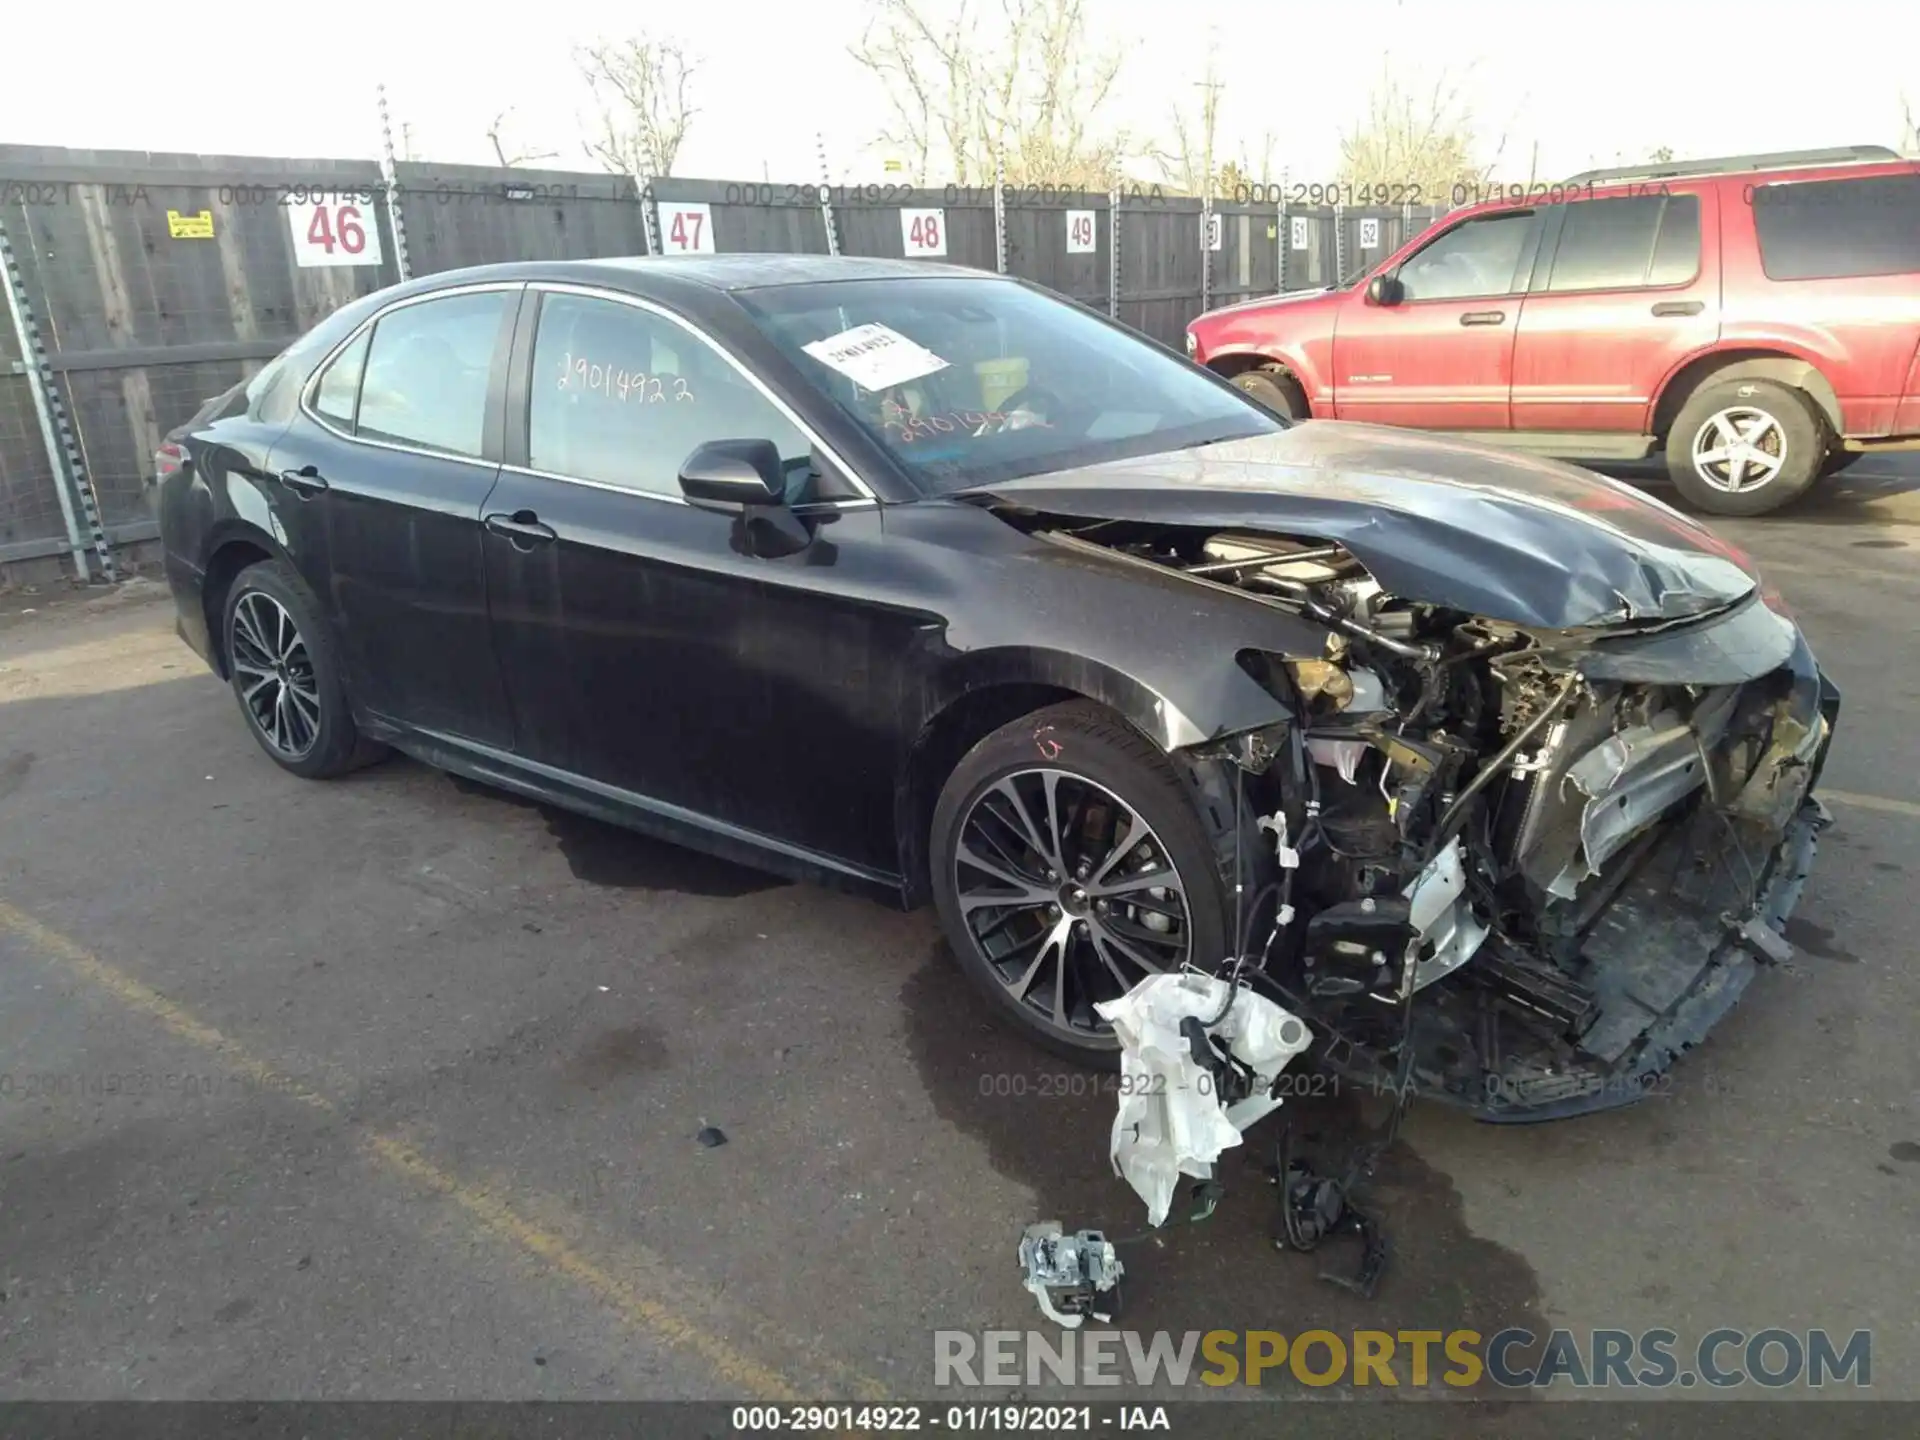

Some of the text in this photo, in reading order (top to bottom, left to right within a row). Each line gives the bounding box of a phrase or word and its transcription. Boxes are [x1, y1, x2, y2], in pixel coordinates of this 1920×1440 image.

[308, 205, 367, 255] 46
[670, 211, 705, 250] 47
[909, 215, 940, 249] 48
[1071, 217, 1092, 246] 49
[1362, 223, 1376, 244] 52
